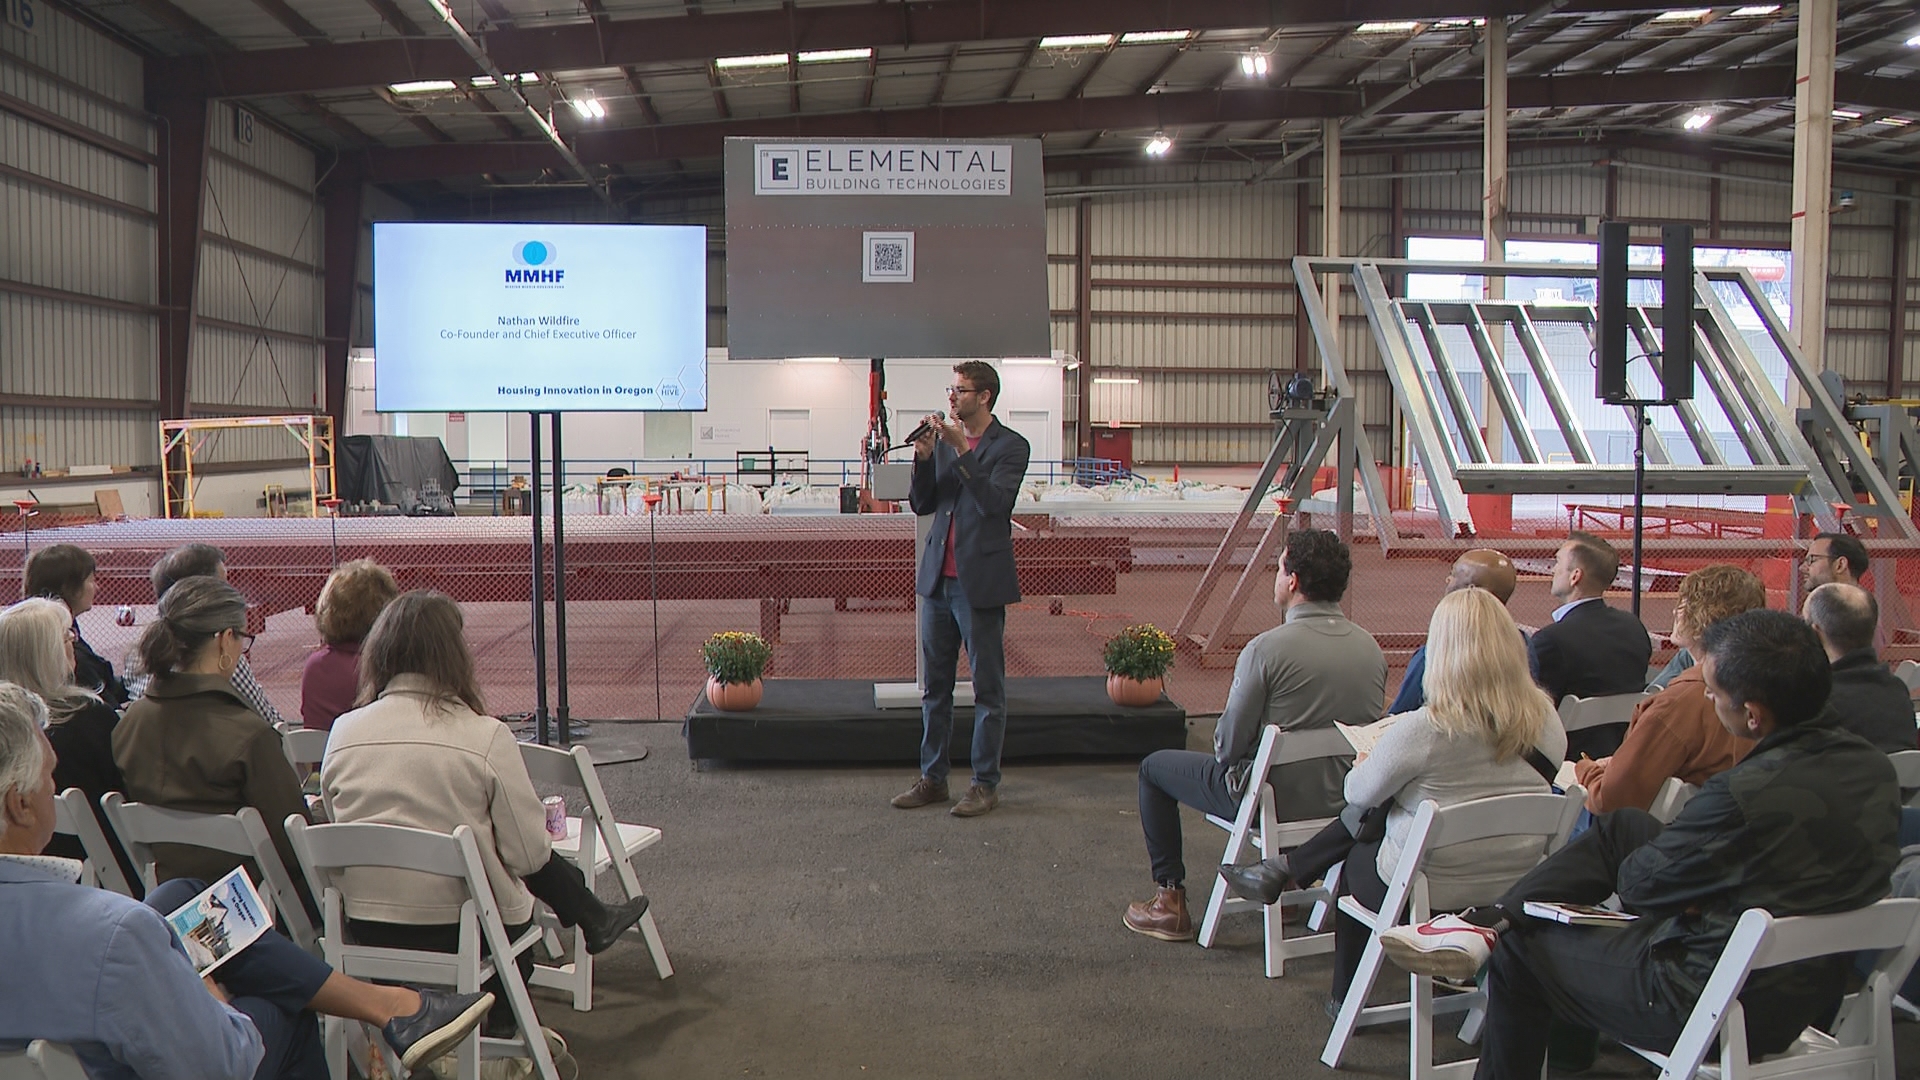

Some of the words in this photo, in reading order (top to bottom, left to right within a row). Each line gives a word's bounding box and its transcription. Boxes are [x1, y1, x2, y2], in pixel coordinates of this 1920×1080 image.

[12, 0, 34, 29] 16
[240, 111, 253, 143] 18
[806, 149, 1006, 173] ELEMENTAL
[772, 158, 788, 181] E
[806, 178, 880, 190] BUILDING
[888, 178, 1006, 190] TECHNOLOGIES
[505, 269, 565, 283] MMHF
[497, 315, 536, 326] Nathan
[538, 315, 580, 326] Wildfire
[440, 328, 500, 340] Co-Founder
[502, 328, 521, 340] and
[523, 328, 550, 340] Chief
[552, 328, 600, 340] Executive
[602, 328, 637, 340] Officer
[497, 386, 541, 397] Housing
[543, 386, 600, 395] Innovation
[602, 386, 612, 395] in
[614, 386, 654, 397] Oregon
